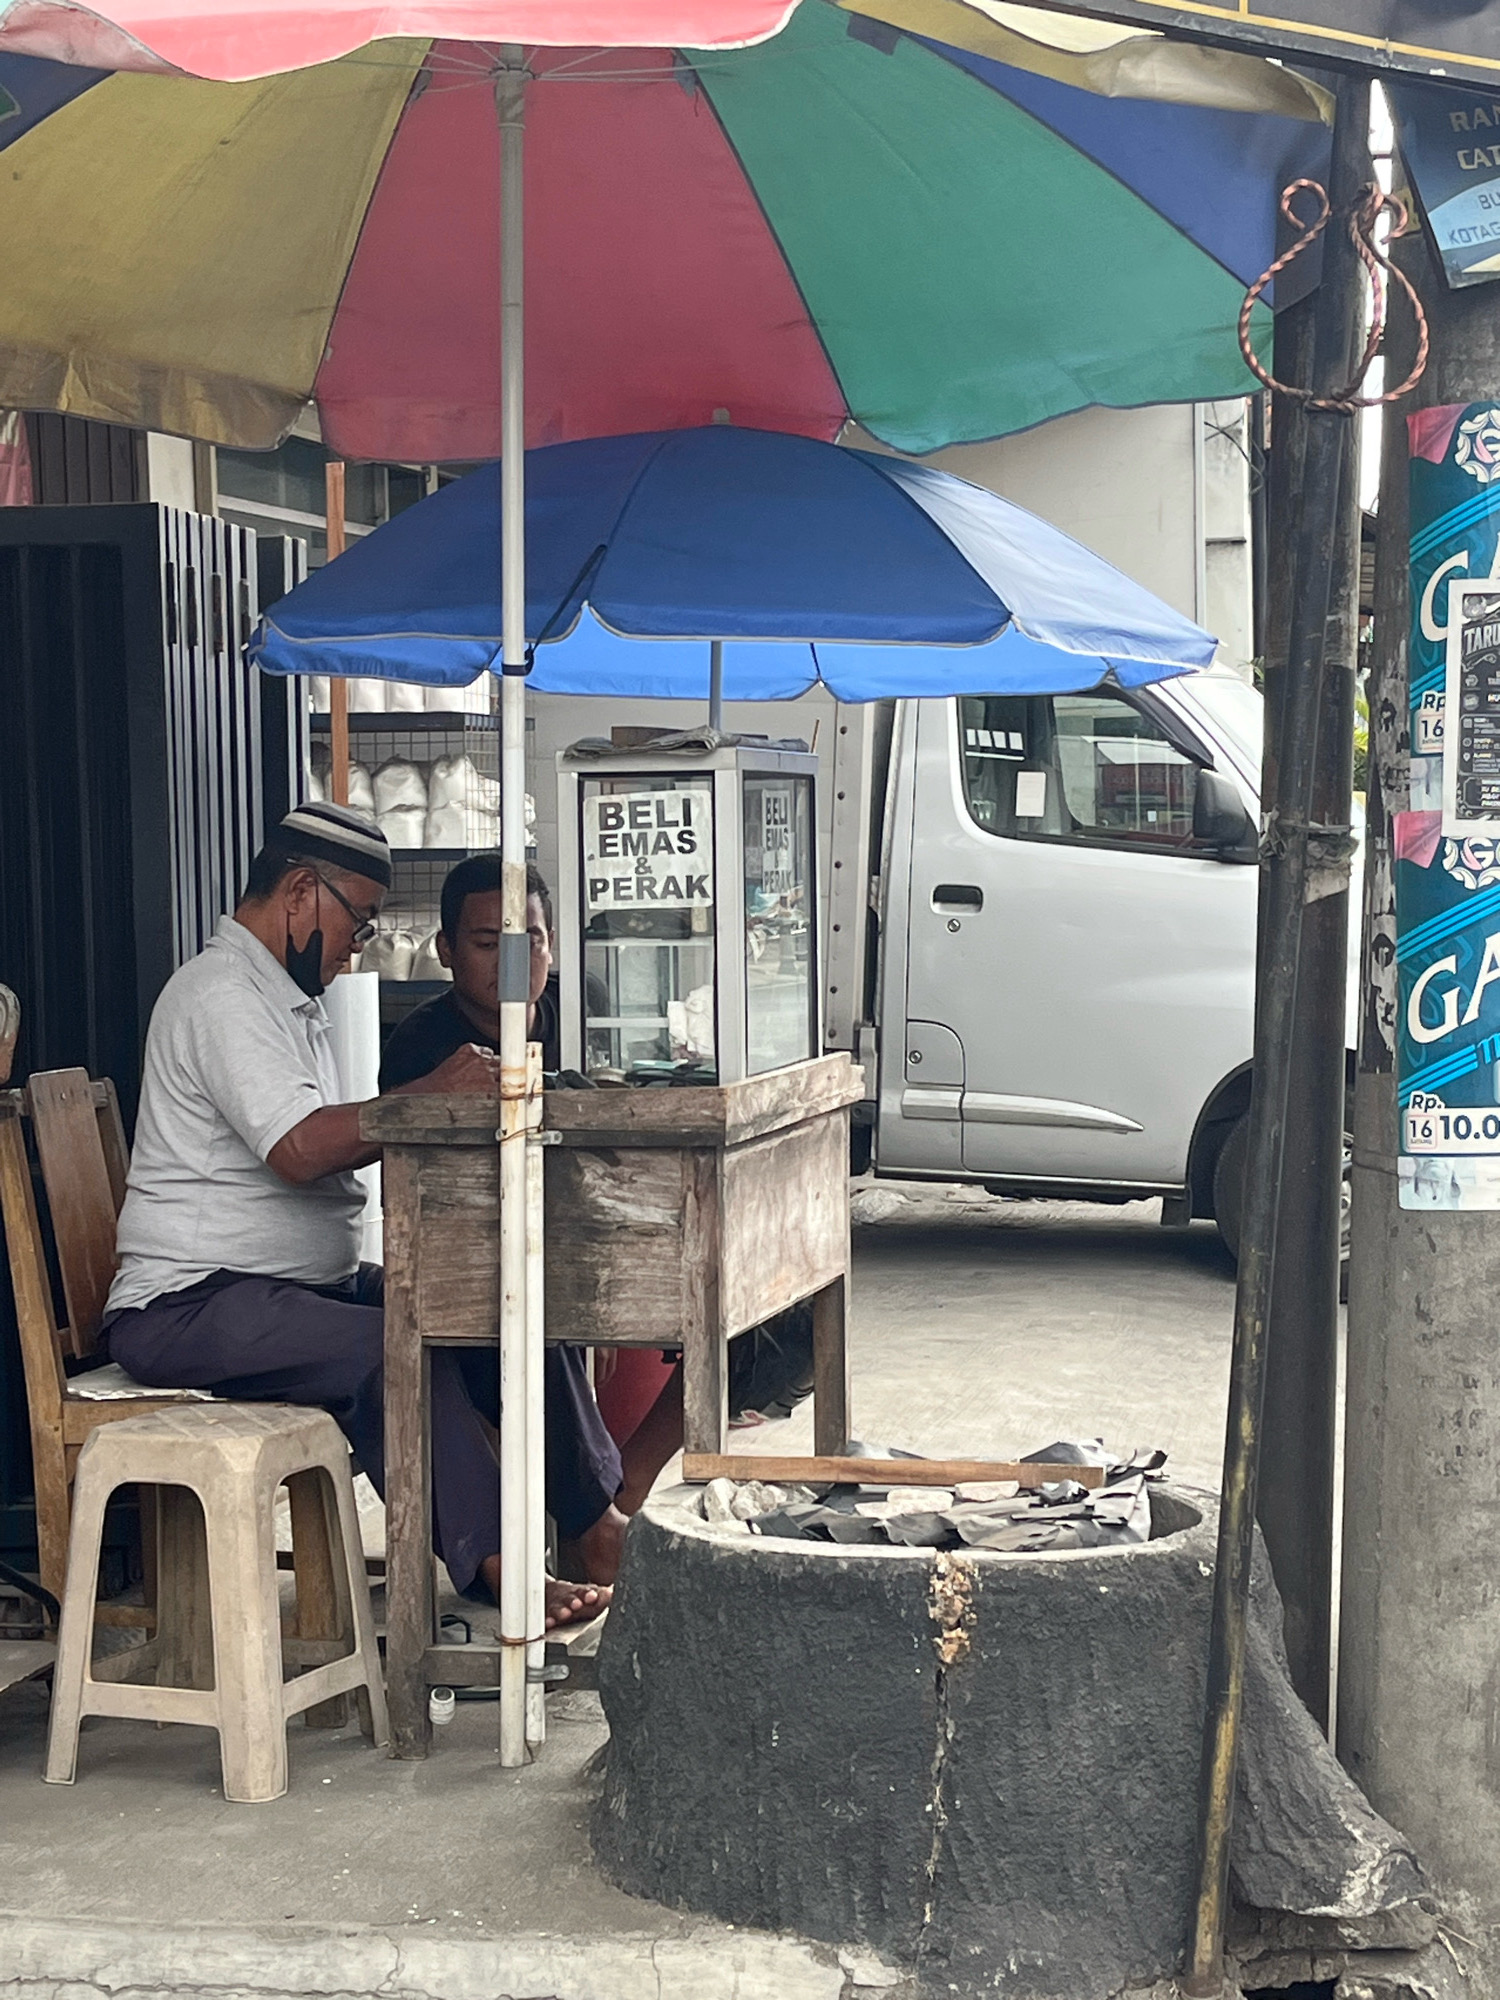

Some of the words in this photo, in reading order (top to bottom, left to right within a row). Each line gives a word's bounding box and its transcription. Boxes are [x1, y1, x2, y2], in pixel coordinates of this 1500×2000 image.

[1421, 719, 1444, 738] 16
[598, 798, 692, 831] BELI
[766, 797, 788, 825] BELI
[598, 829, 697, 858] EMAS
[766, 827, 790, 852] EMAS
[634, 857, 652, 875] &
[589, 874, 710, 902] PERAK
[764, 870, 792, 894] PERAK
[1411, 1094, 1442, 1113] Rp.
[1409, 1120, 1433, 1138] 16
[1439, 1114, 1500, 1140] 10.0
